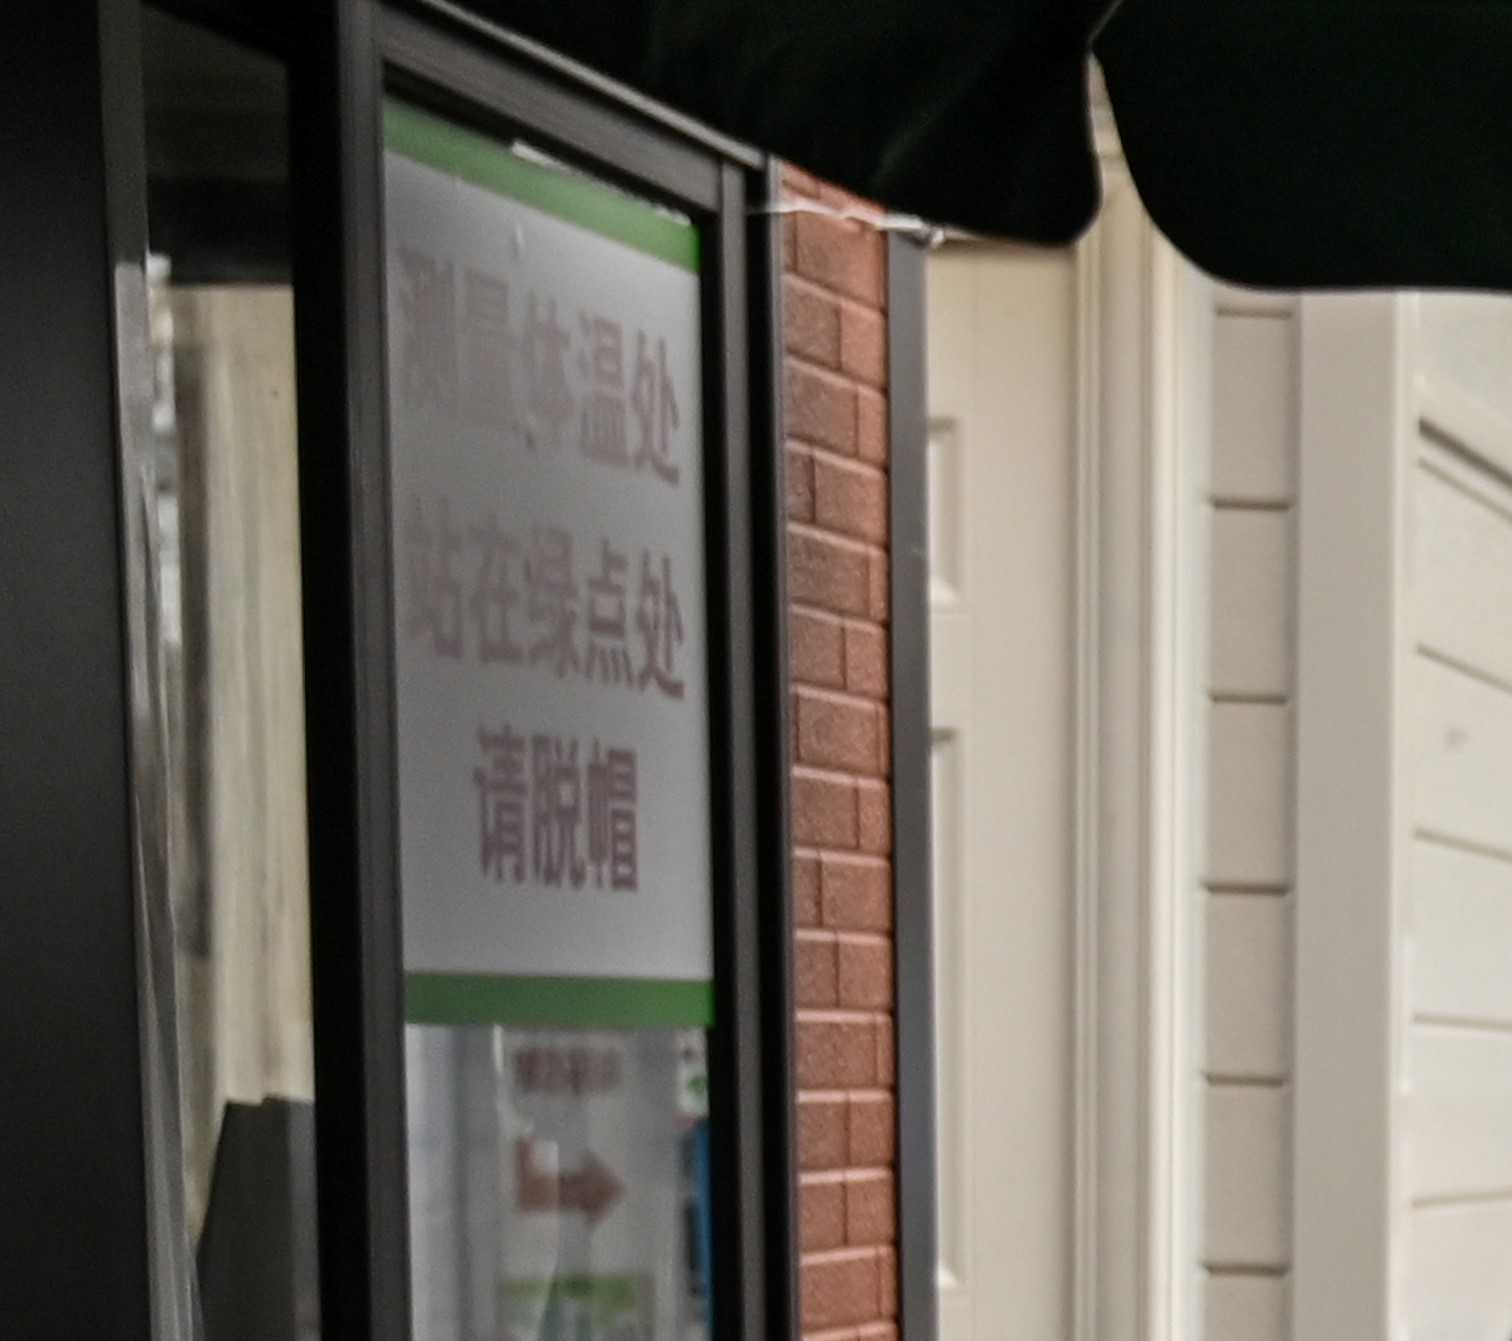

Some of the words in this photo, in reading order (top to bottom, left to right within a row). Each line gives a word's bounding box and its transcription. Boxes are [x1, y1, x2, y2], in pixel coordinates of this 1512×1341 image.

[408, 494, 685, 702] 站在绿点处
[474, 723, 641, 891] 请脱帽
